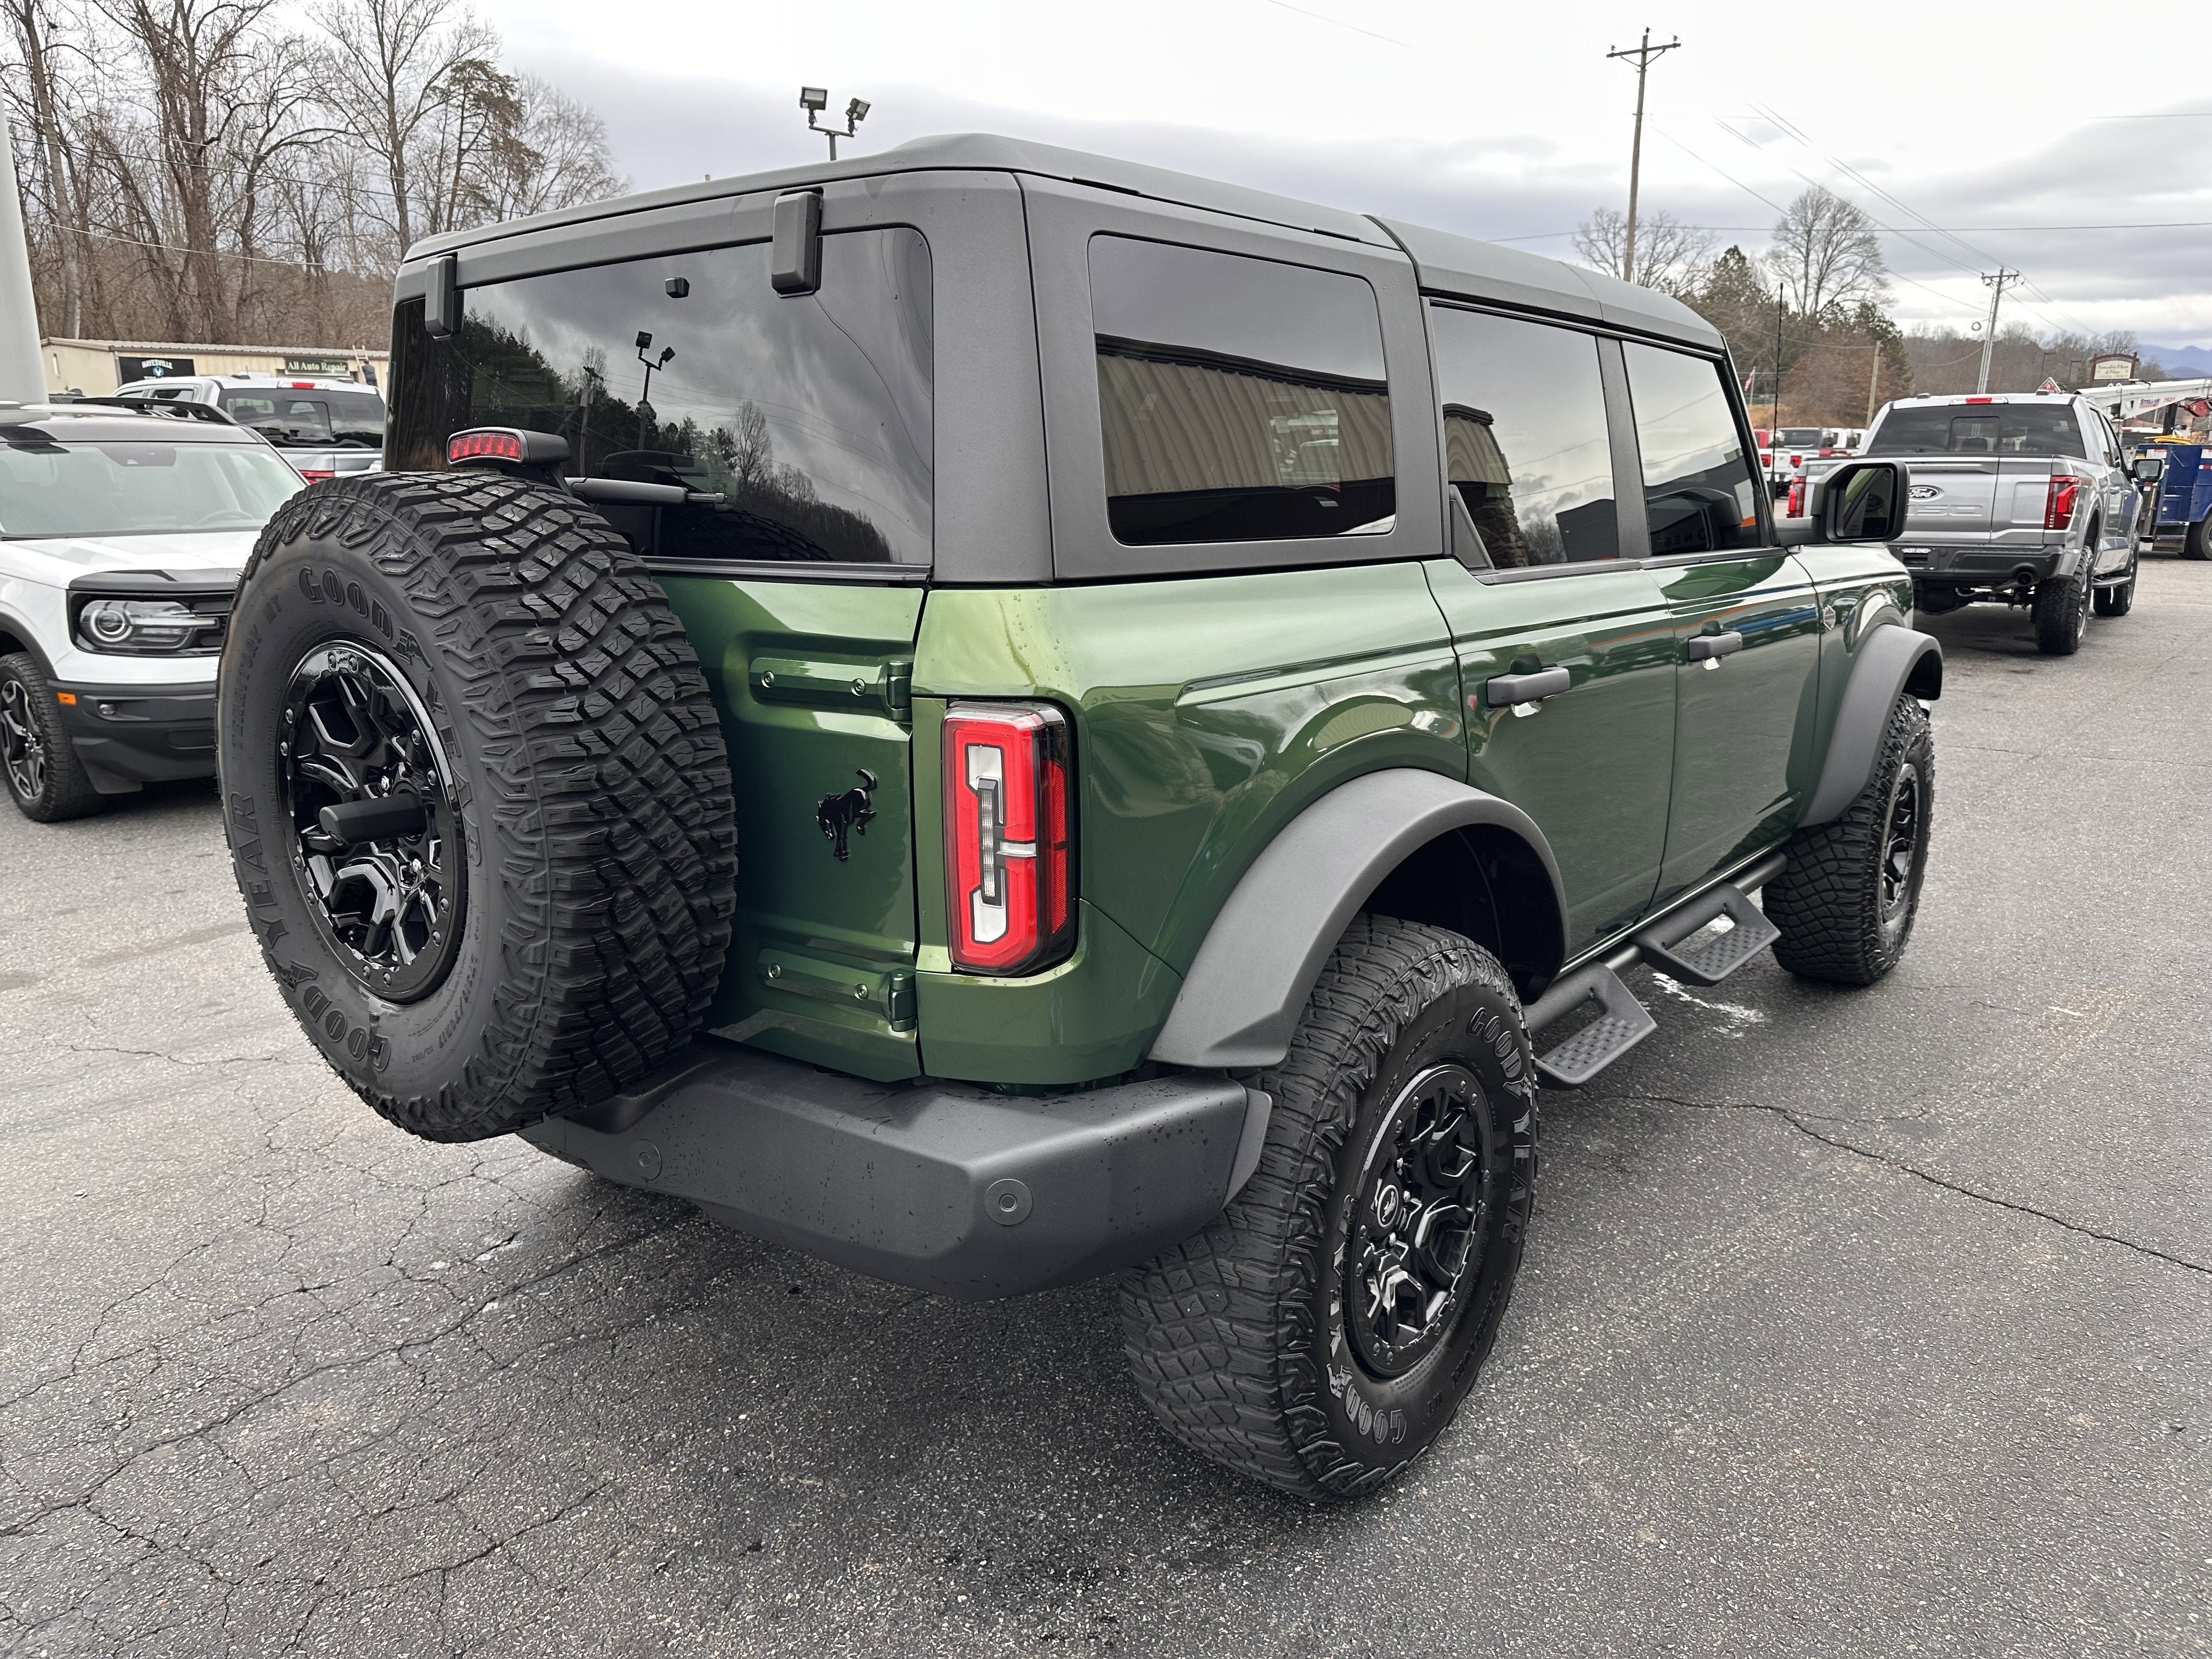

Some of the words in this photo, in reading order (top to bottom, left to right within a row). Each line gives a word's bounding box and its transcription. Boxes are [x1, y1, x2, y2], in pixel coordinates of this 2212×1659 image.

[287, 361, 300, 370] All
[301, 362, 320, 370] Auto
[321, 362, 347, 373] Repair
[1909, 488, 1933, 498] Ford
